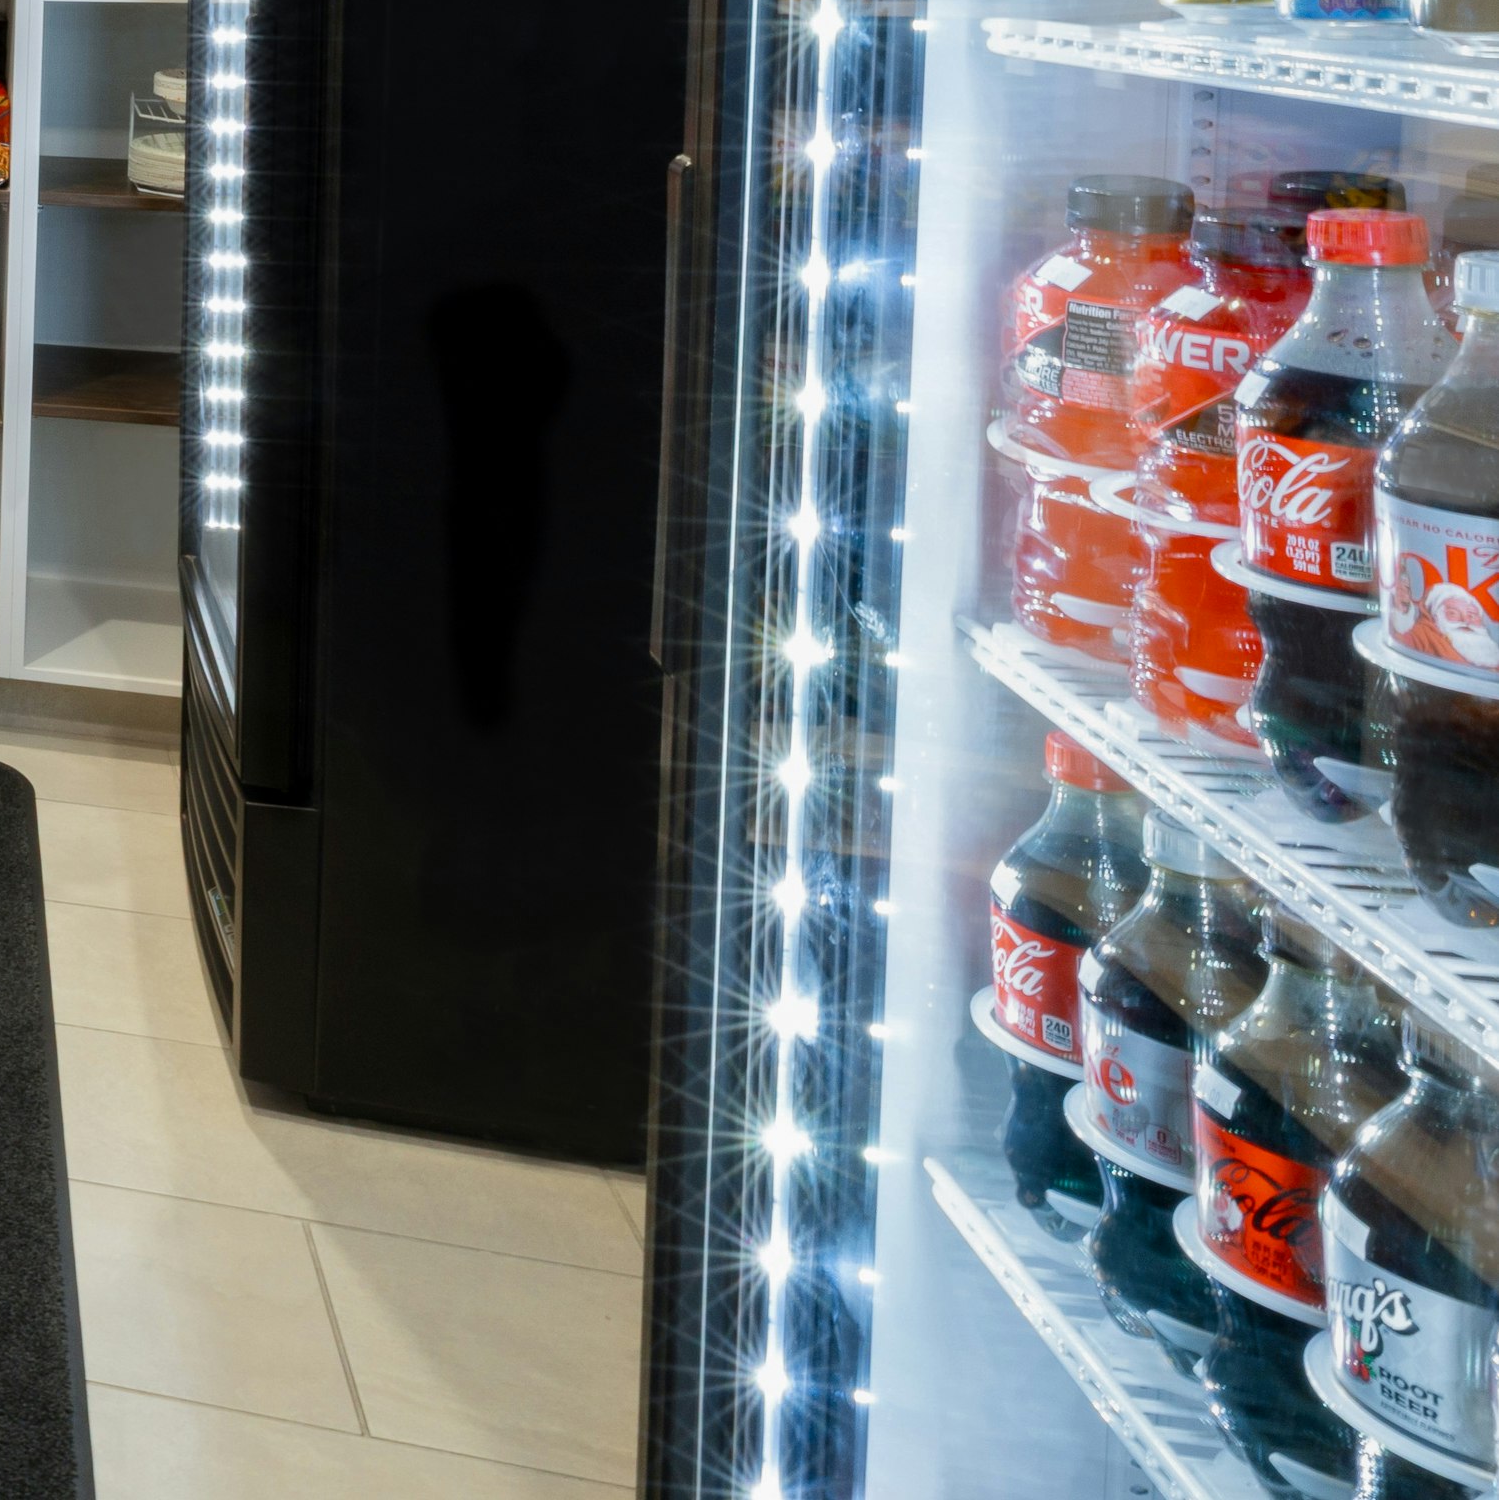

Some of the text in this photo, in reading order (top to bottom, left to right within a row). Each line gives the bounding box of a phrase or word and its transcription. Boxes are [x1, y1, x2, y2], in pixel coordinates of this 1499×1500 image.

[1068, 302, 1112, 320] Nutrition
[1422, 523, 1440, 535] NO
[1335, 546, 1371, 563] 240
[1045, 1016, 1072, 1039] 240
[1378, 1365, 1444, 1406] ROOT
[1379, 1383, 1440, 1425] BEER
